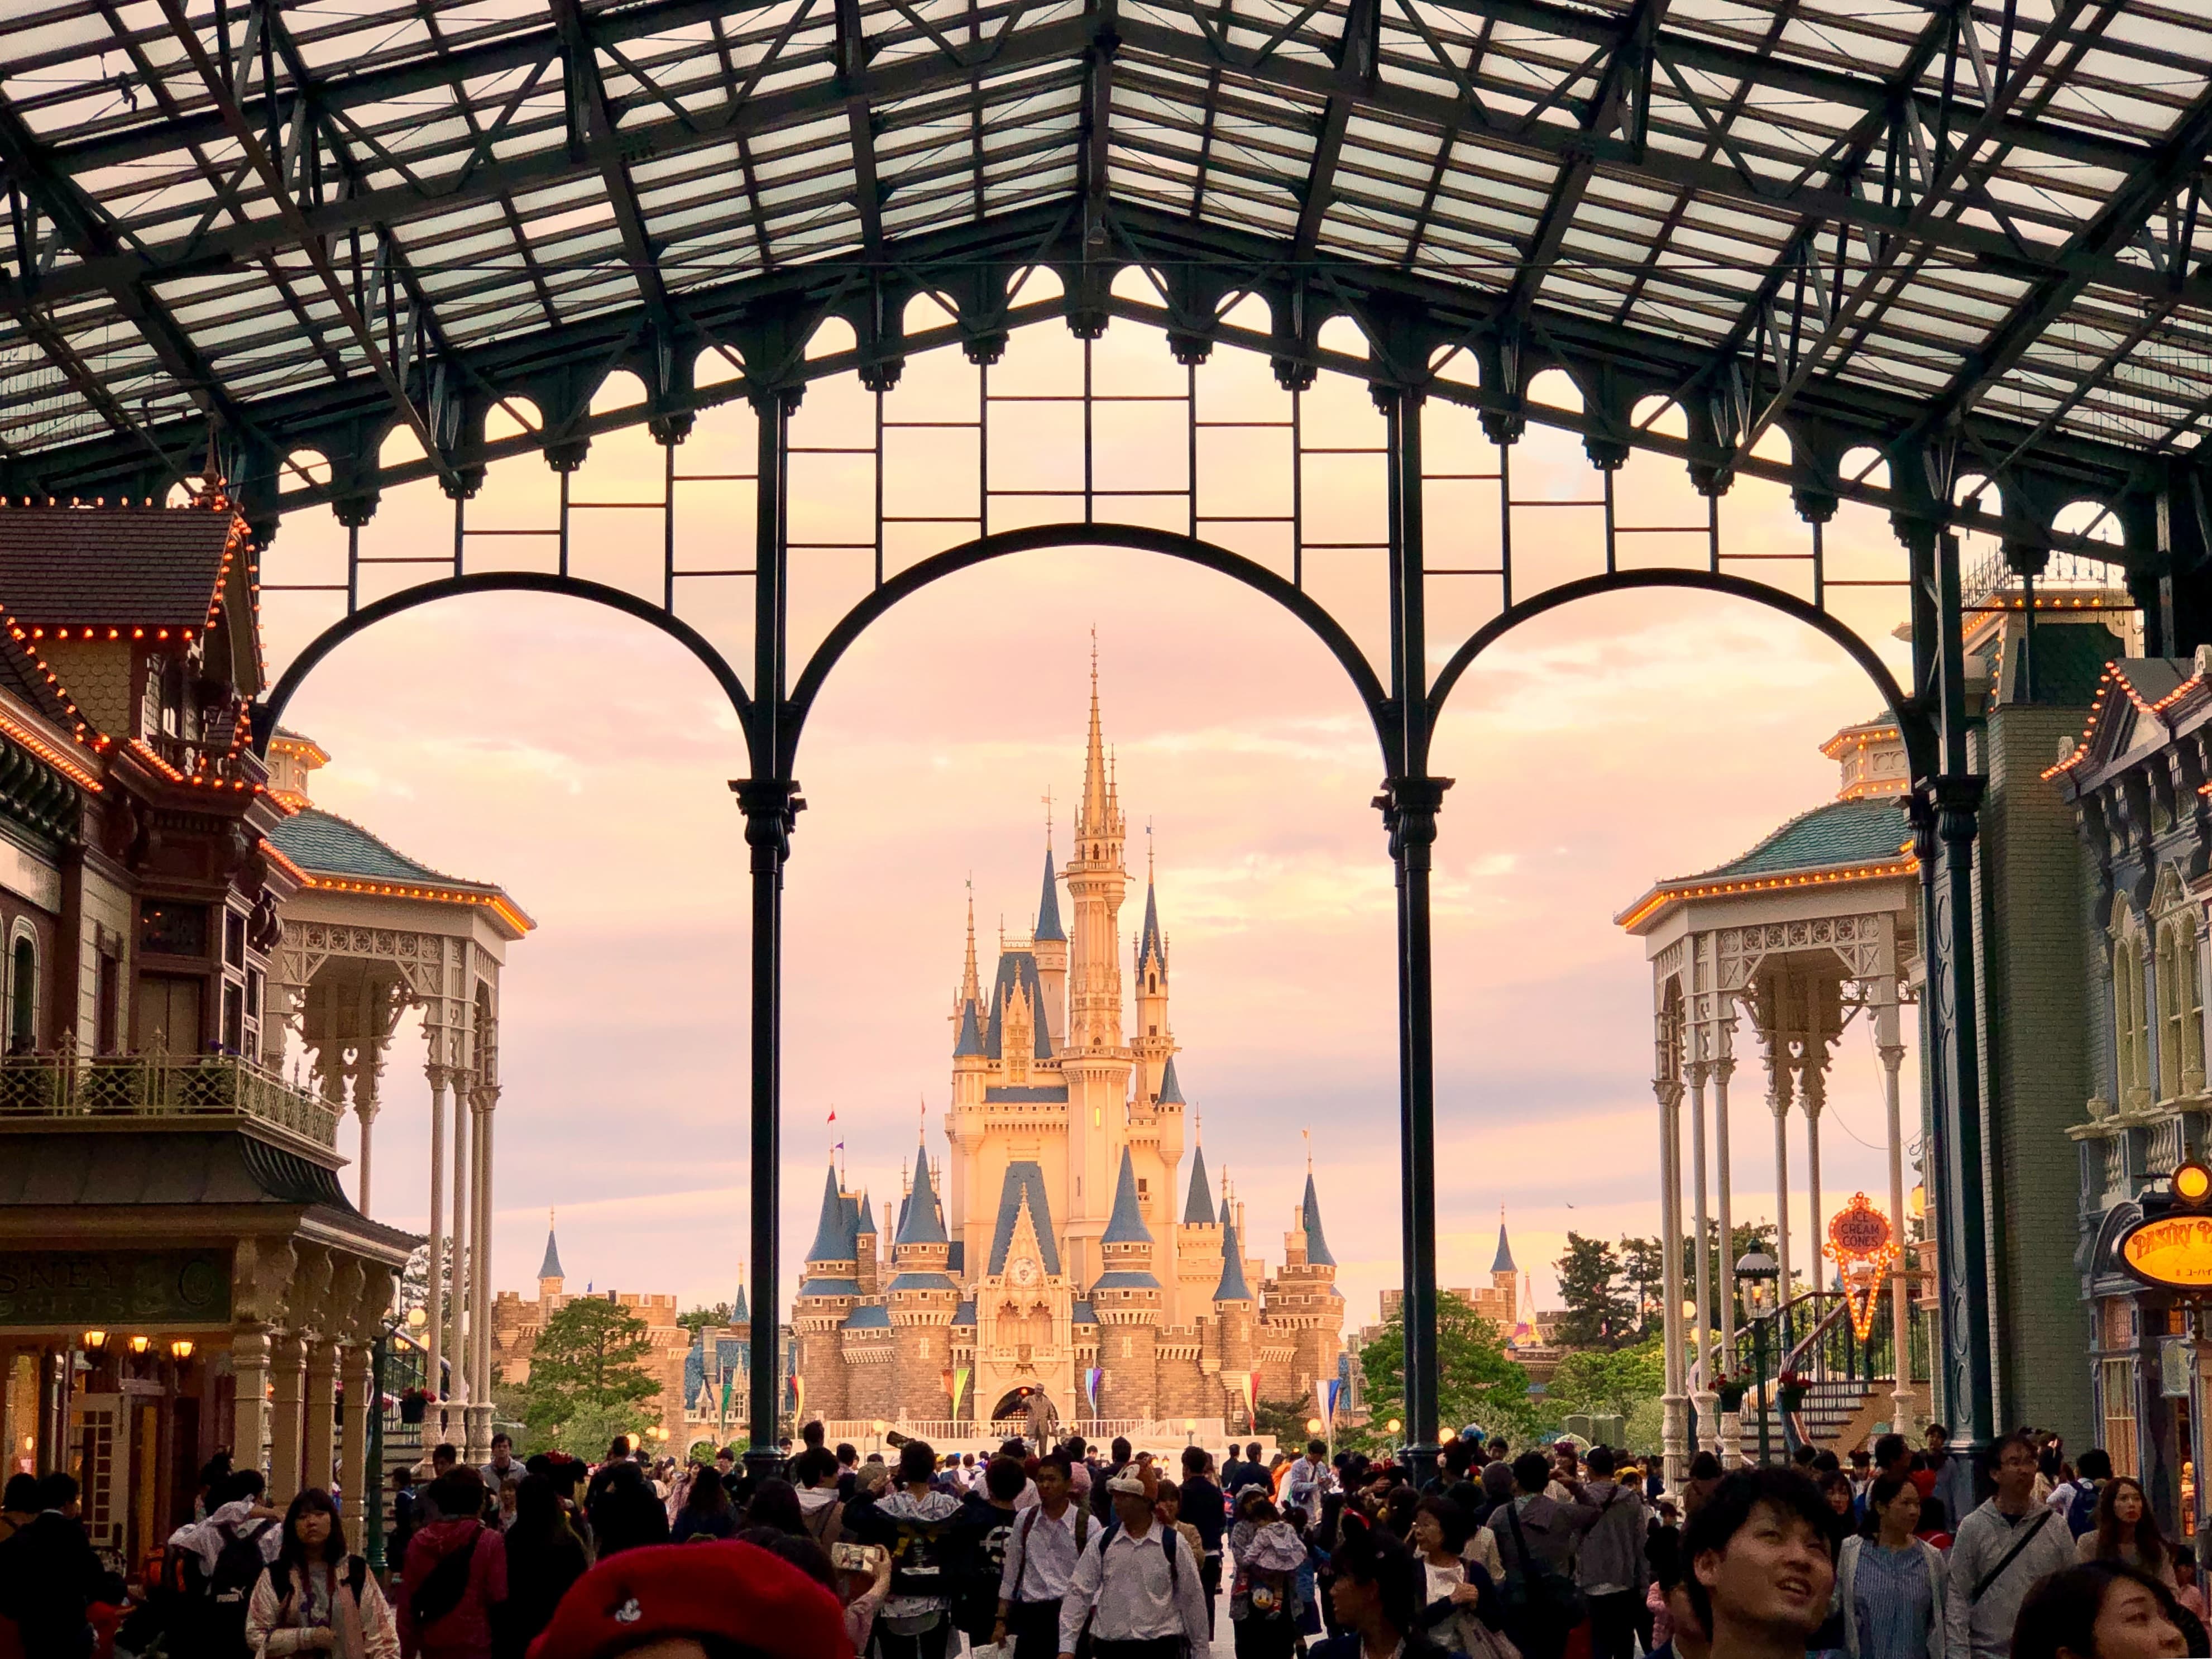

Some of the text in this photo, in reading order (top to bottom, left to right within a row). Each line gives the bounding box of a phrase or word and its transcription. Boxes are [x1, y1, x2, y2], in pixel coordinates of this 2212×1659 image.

[1852, 1211, 1868, 1222] ICE
[1841, 1223, 1879, 1235] CREAM
[1842, 1235, 1878, 1247] CONES
[2132, 1222, 2194, 1260] PASTRY
